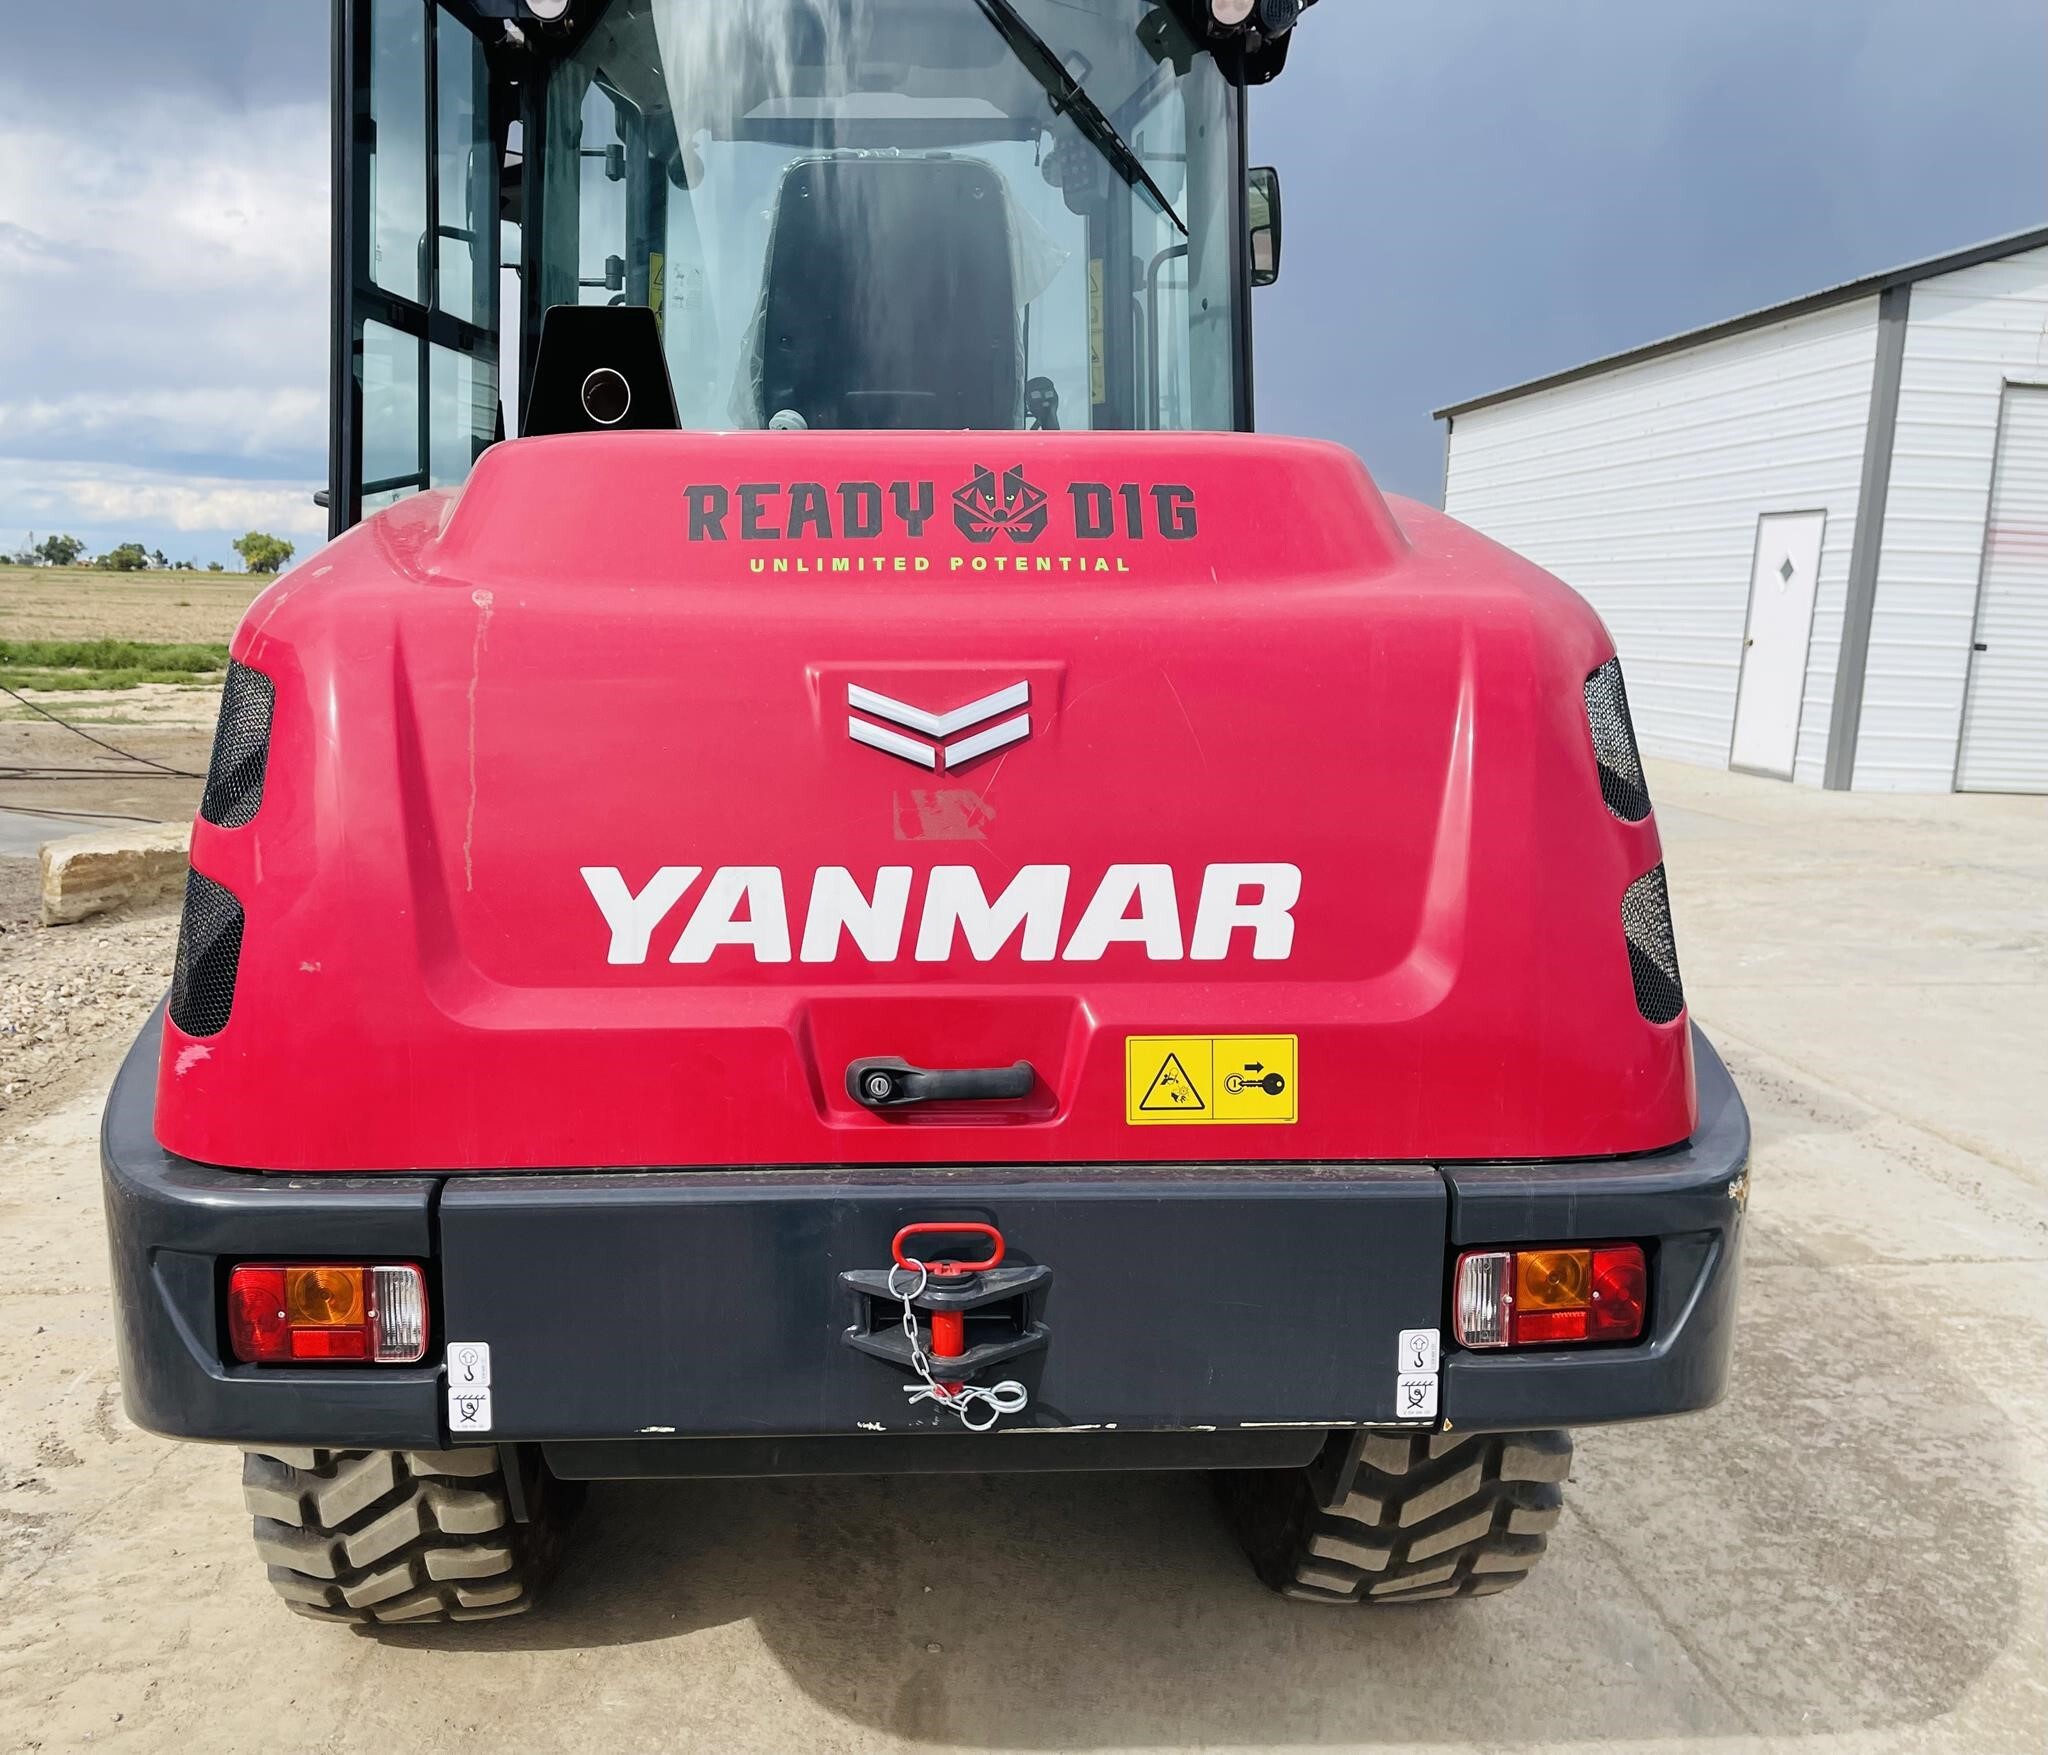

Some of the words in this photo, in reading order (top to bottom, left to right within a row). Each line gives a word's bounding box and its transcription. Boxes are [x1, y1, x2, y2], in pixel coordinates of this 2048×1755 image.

[682, 480, 935, 542] READY
[1066, 481, 1199, 541] DIG
[749, 556, 931, 573] UNLIMITED
[950, 556, 1130, 573] POTENTIAL
[579, 862, 1302, 966] YANMAR
